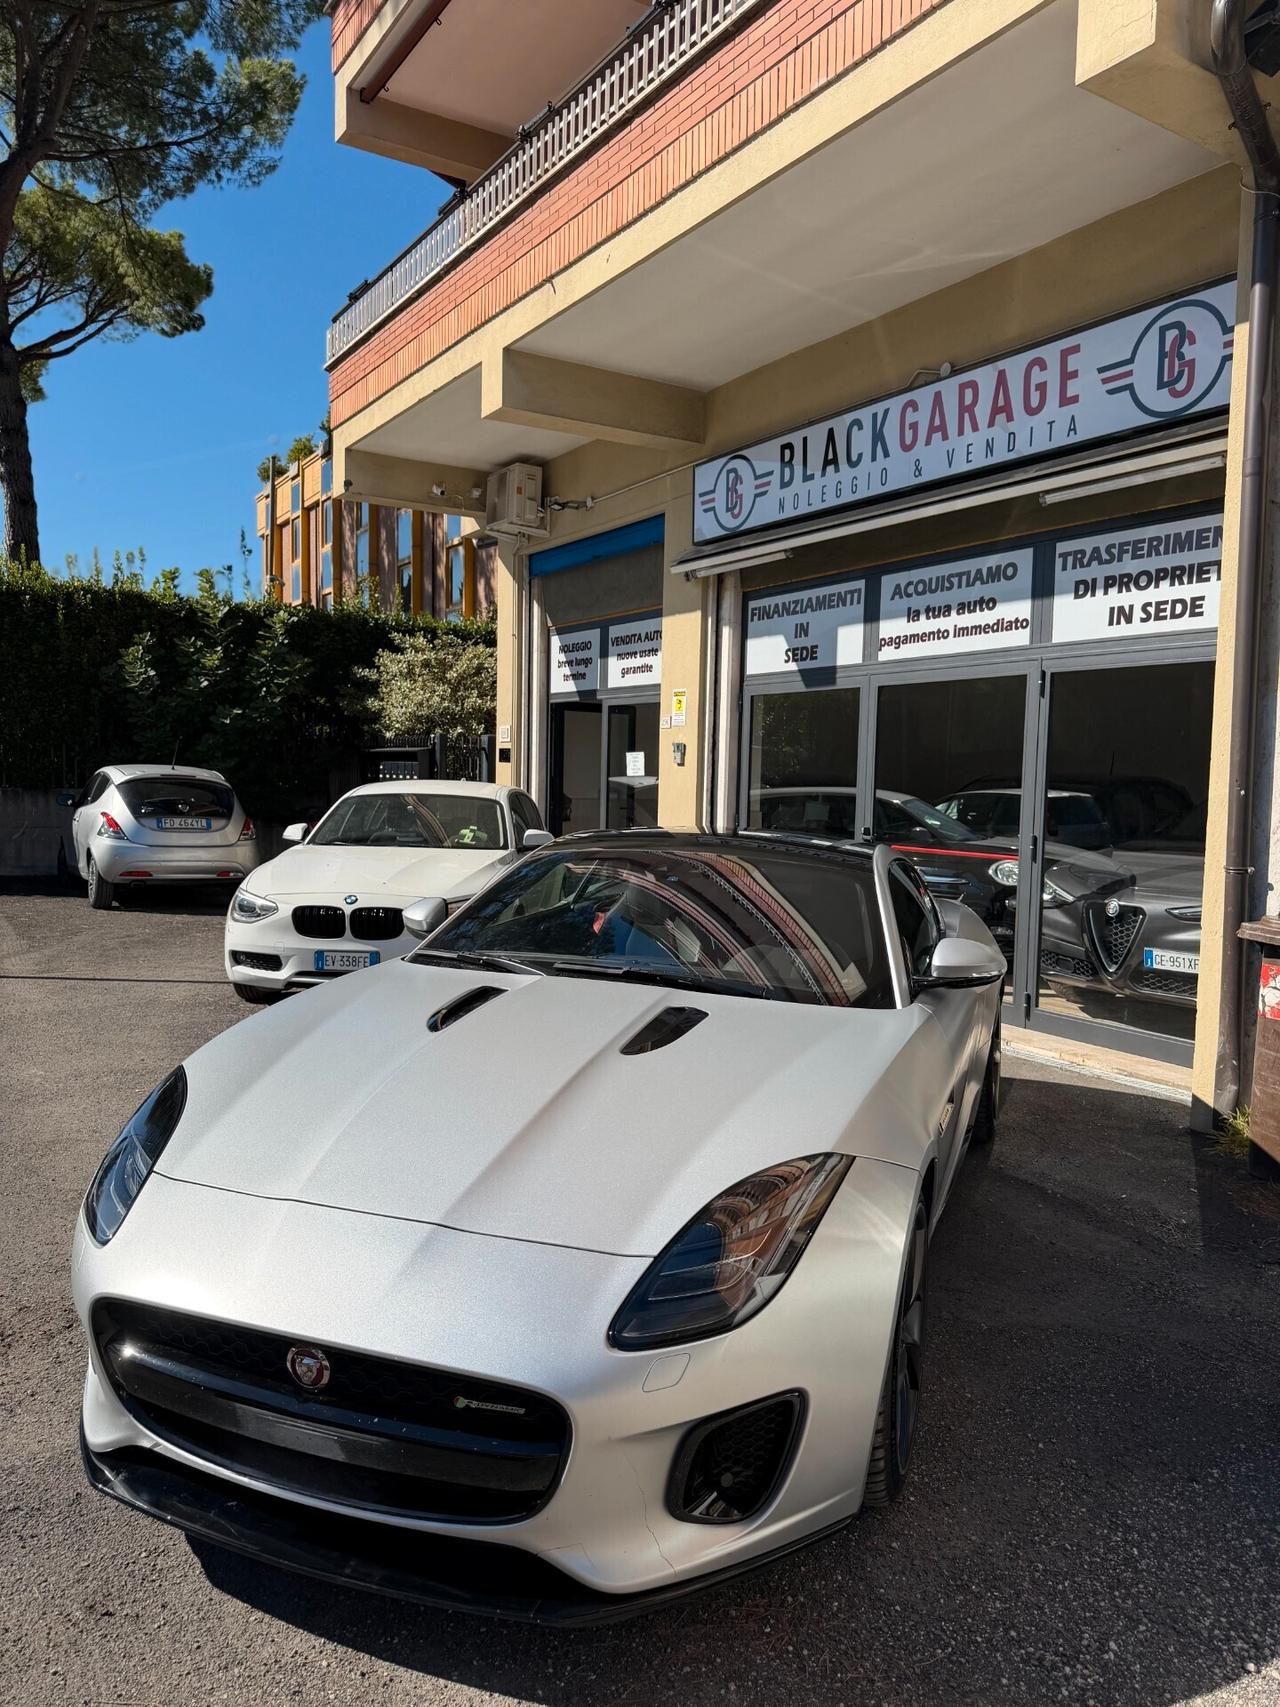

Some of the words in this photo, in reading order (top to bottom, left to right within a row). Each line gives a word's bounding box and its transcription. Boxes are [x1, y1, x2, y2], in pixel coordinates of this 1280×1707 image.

[778, 466, 888, 515] NOLEGGIO
[913, 458, 923, 478] &
[946, 414, 1078, 468] VENDITA
[890, 562, 1018, 600] ACQUISTIAMO
[1073, 579, 1097, 599] DI
[750, 588, 862, 622] FINANZIAMENTI
[907, 607, 920, 623] la
[925, 601, 951, 620] tua
[956, 596, 997, 615] auto
[1107, 605, 1135, 627] IN
[1139, 595, 1205, 623] SEDE
[794, 622, 809, 638] IN
[878, 628, 950, 651] pagamento
[953, 617, 1029, 638] immediato
[559, 640, 592, 654] NOLEGGIO
[610, 632, 642, 647] VENDITA
[558, 657, 574, 668] breve
[575, 656, 593, 668] lungo
[617, 651, 638, 661] nuove
[639, 647, 658, 658] usate
[784, 645, 818, 663] SEDE
[563, 671, 587, 682] termine
[621, 663, 653, 678] garantite
